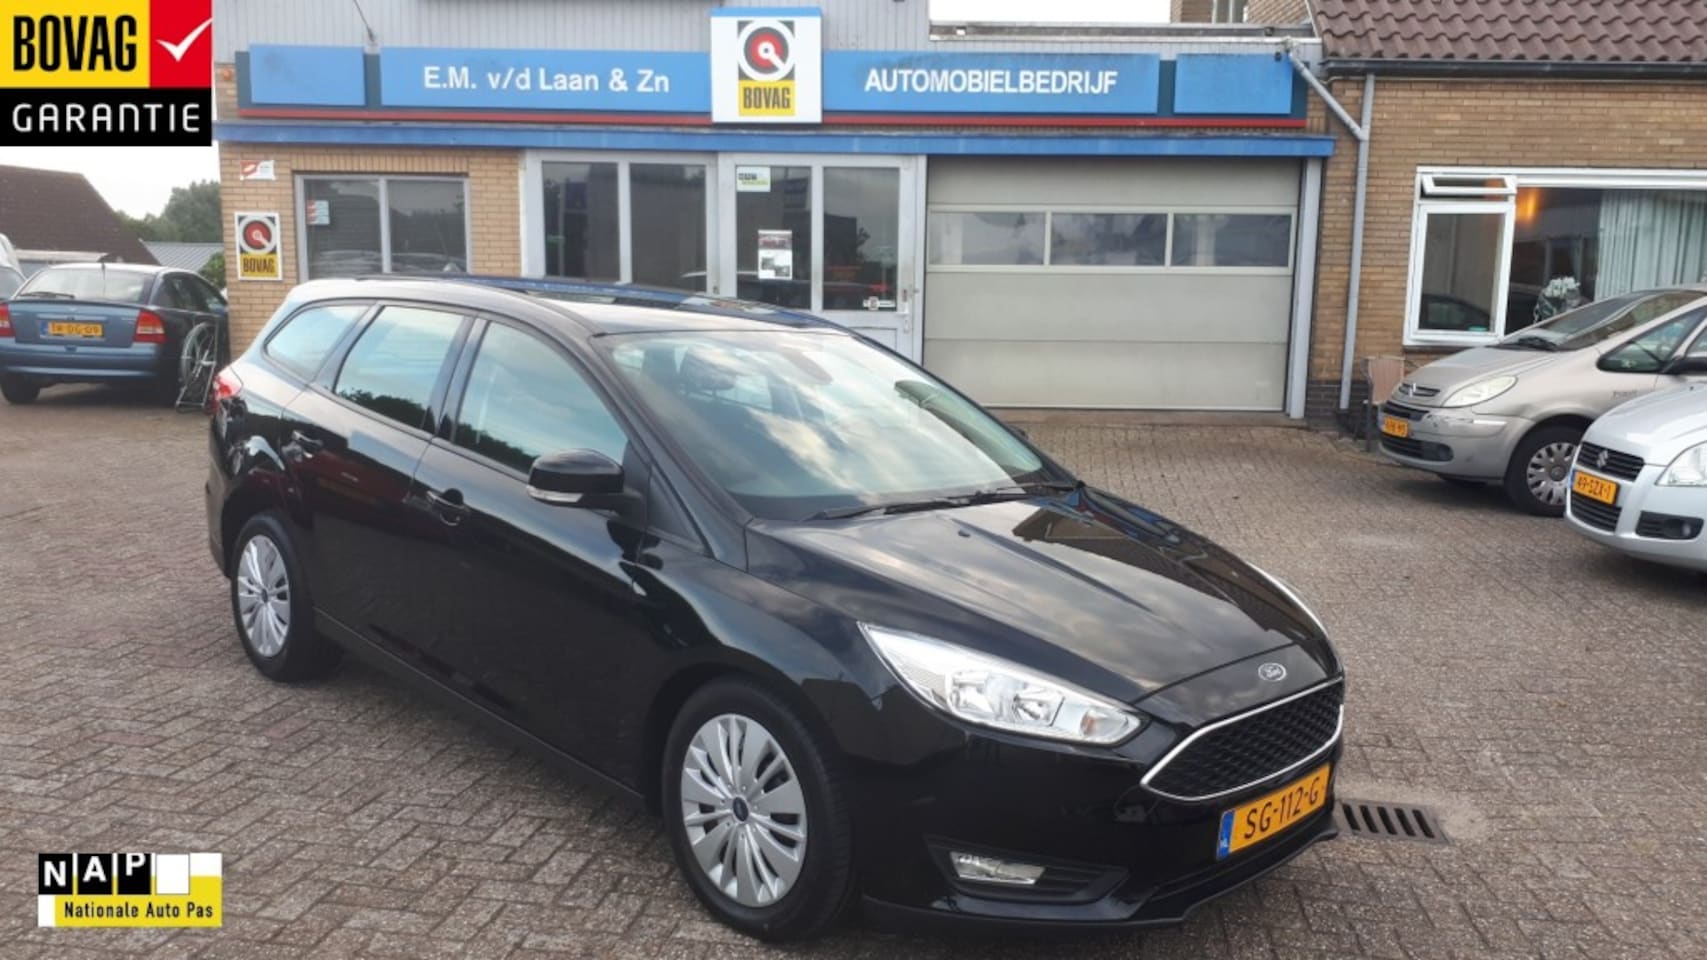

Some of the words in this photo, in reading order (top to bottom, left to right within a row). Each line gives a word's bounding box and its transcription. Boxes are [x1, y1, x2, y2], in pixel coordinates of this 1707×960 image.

[423, 66, 476, 89] E.M.
[487, 67, 531, 90] v/d
[539, 68, 599, 91] Laan
[608, 68, 628, 92] &
[636, 69, 670, 92] Zn
[864, 69, 1118, 95] AUTOMOBIELBEDRIJF
[742, 86, 792, 110] BOVAG
[243, 258, 276, 273] BOVAG
[1243, 776, 1320, 839] SG-112-G
